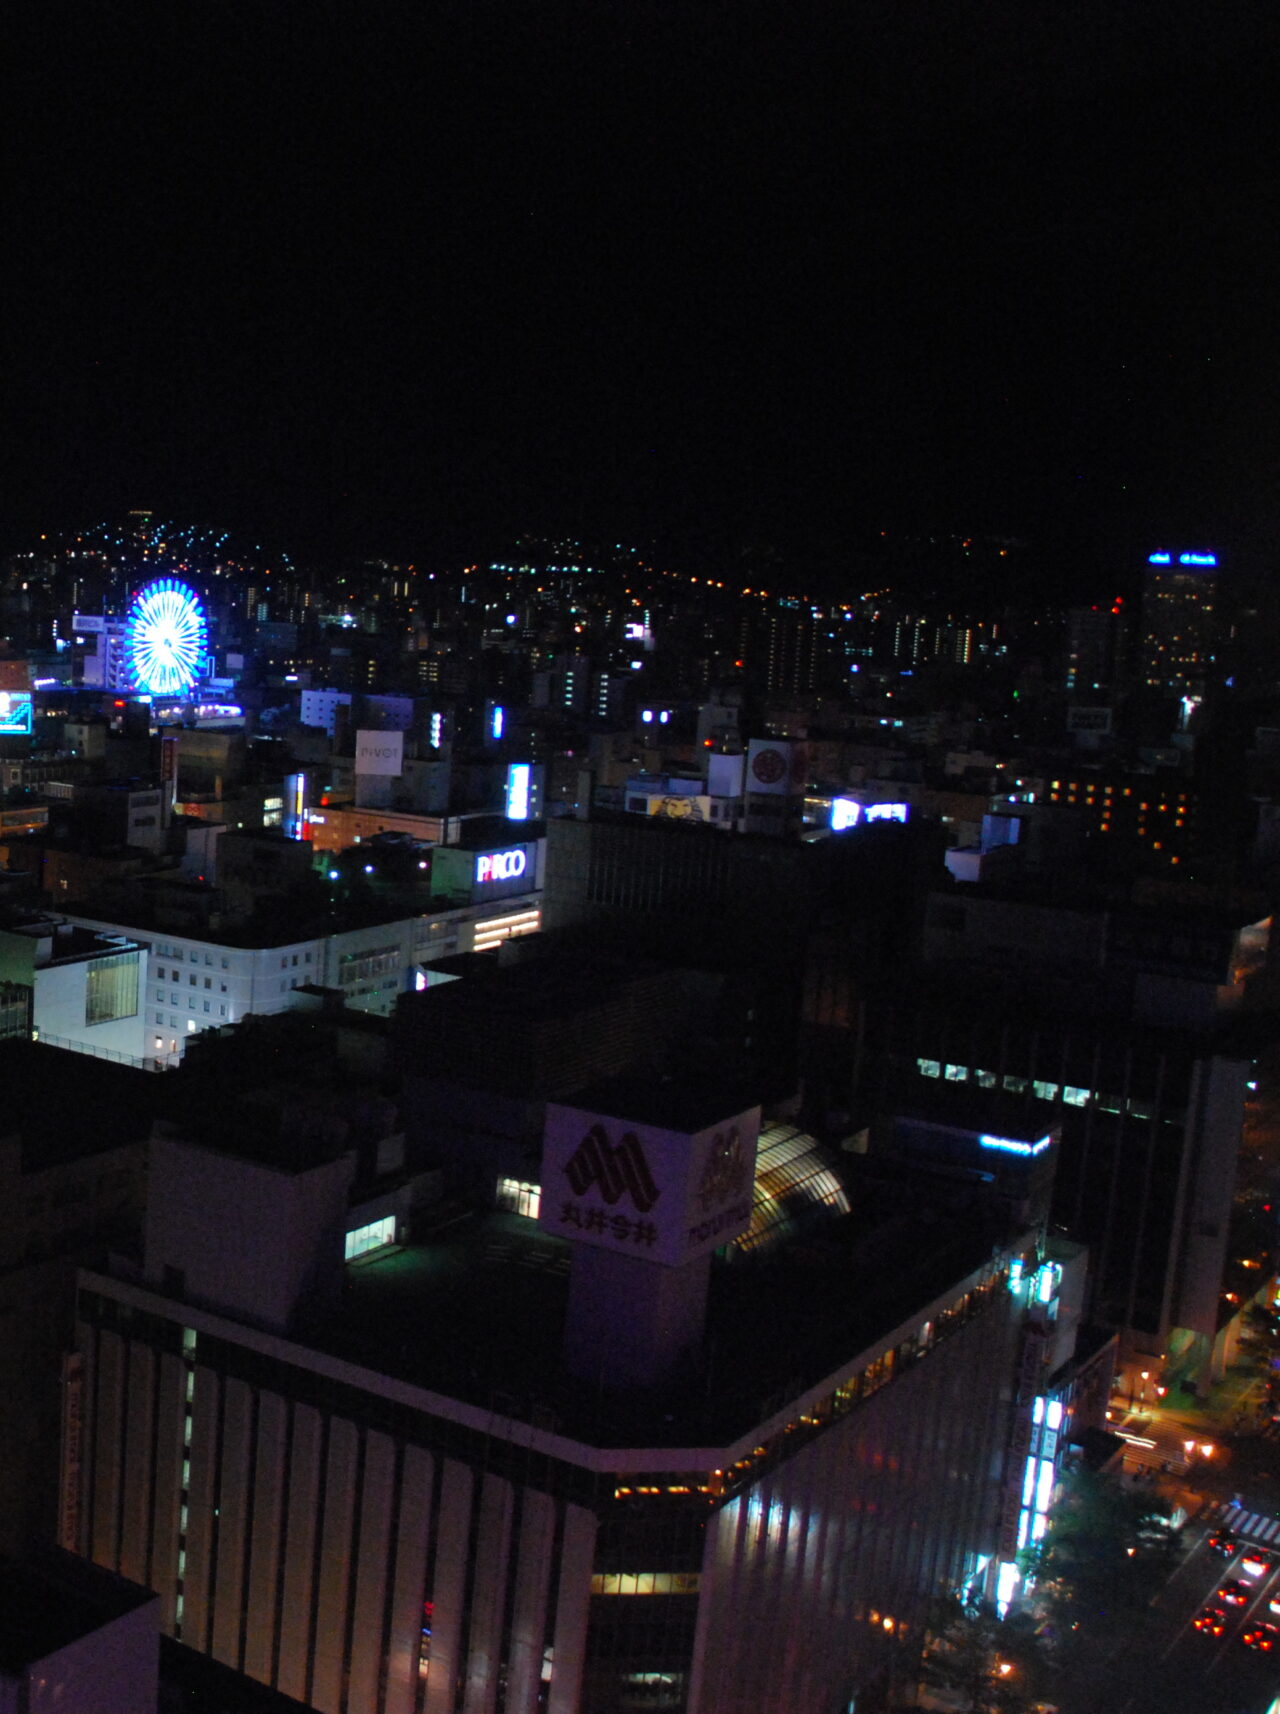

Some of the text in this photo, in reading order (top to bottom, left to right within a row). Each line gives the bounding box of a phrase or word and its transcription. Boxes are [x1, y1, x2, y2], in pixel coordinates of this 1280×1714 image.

[477, 849, 526, 882] PARCO
[559, 1201, 658, 1247] 丸井今井
